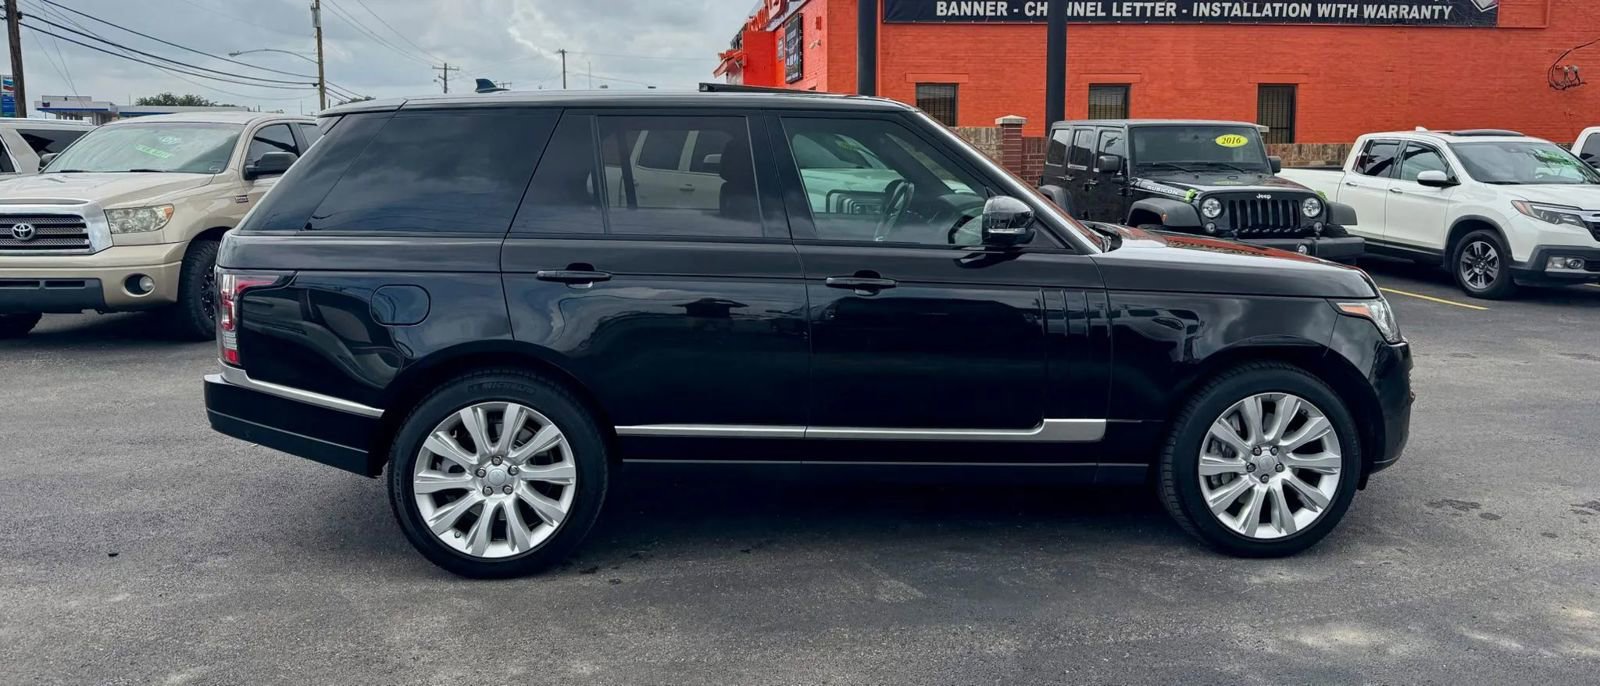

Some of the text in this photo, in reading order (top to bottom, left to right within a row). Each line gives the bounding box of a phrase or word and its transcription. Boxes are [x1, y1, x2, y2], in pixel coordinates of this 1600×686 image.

[936, 1, 1008, 17] BANNER
[1024, 1, 1107, 17] CHNNEL
[1111, 1, 1177, 17] LETTER
[1192, 2, 1312, 18] INSTALLATION
[1316, 3, 1359, 19] WITH
[1362, 4, 1453, 20] WARRANTY
[1221, 136, 1241, 145] 2016
[1146, 185, 1178, 195] RUBICON
